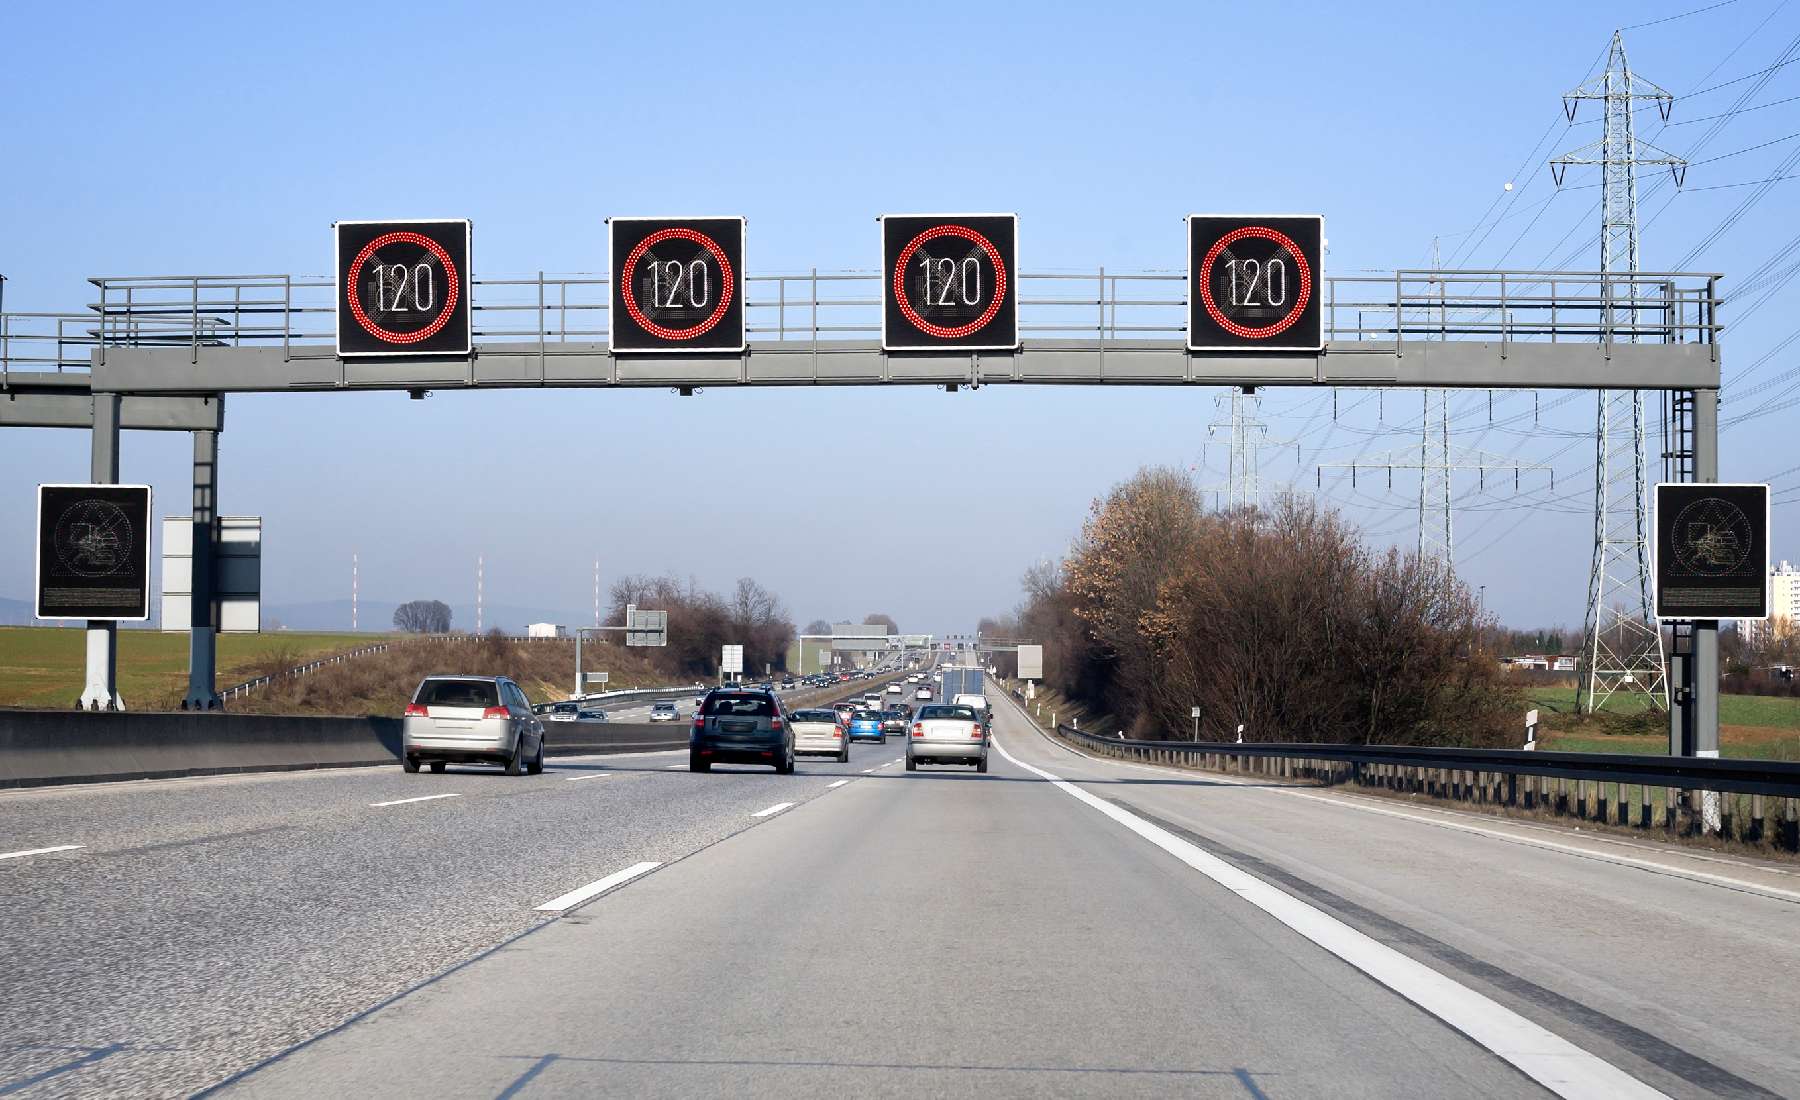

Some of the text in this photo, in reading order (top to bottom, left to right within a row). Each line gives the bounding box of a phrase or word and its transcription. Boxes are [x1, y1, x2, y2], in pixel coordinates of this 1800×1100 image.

[372, 264, 433, 312] 120
[647, 260, 708, 308] 120
[919, 257, 981, 306] 120
[1225, 259, 1286, 306] 120
